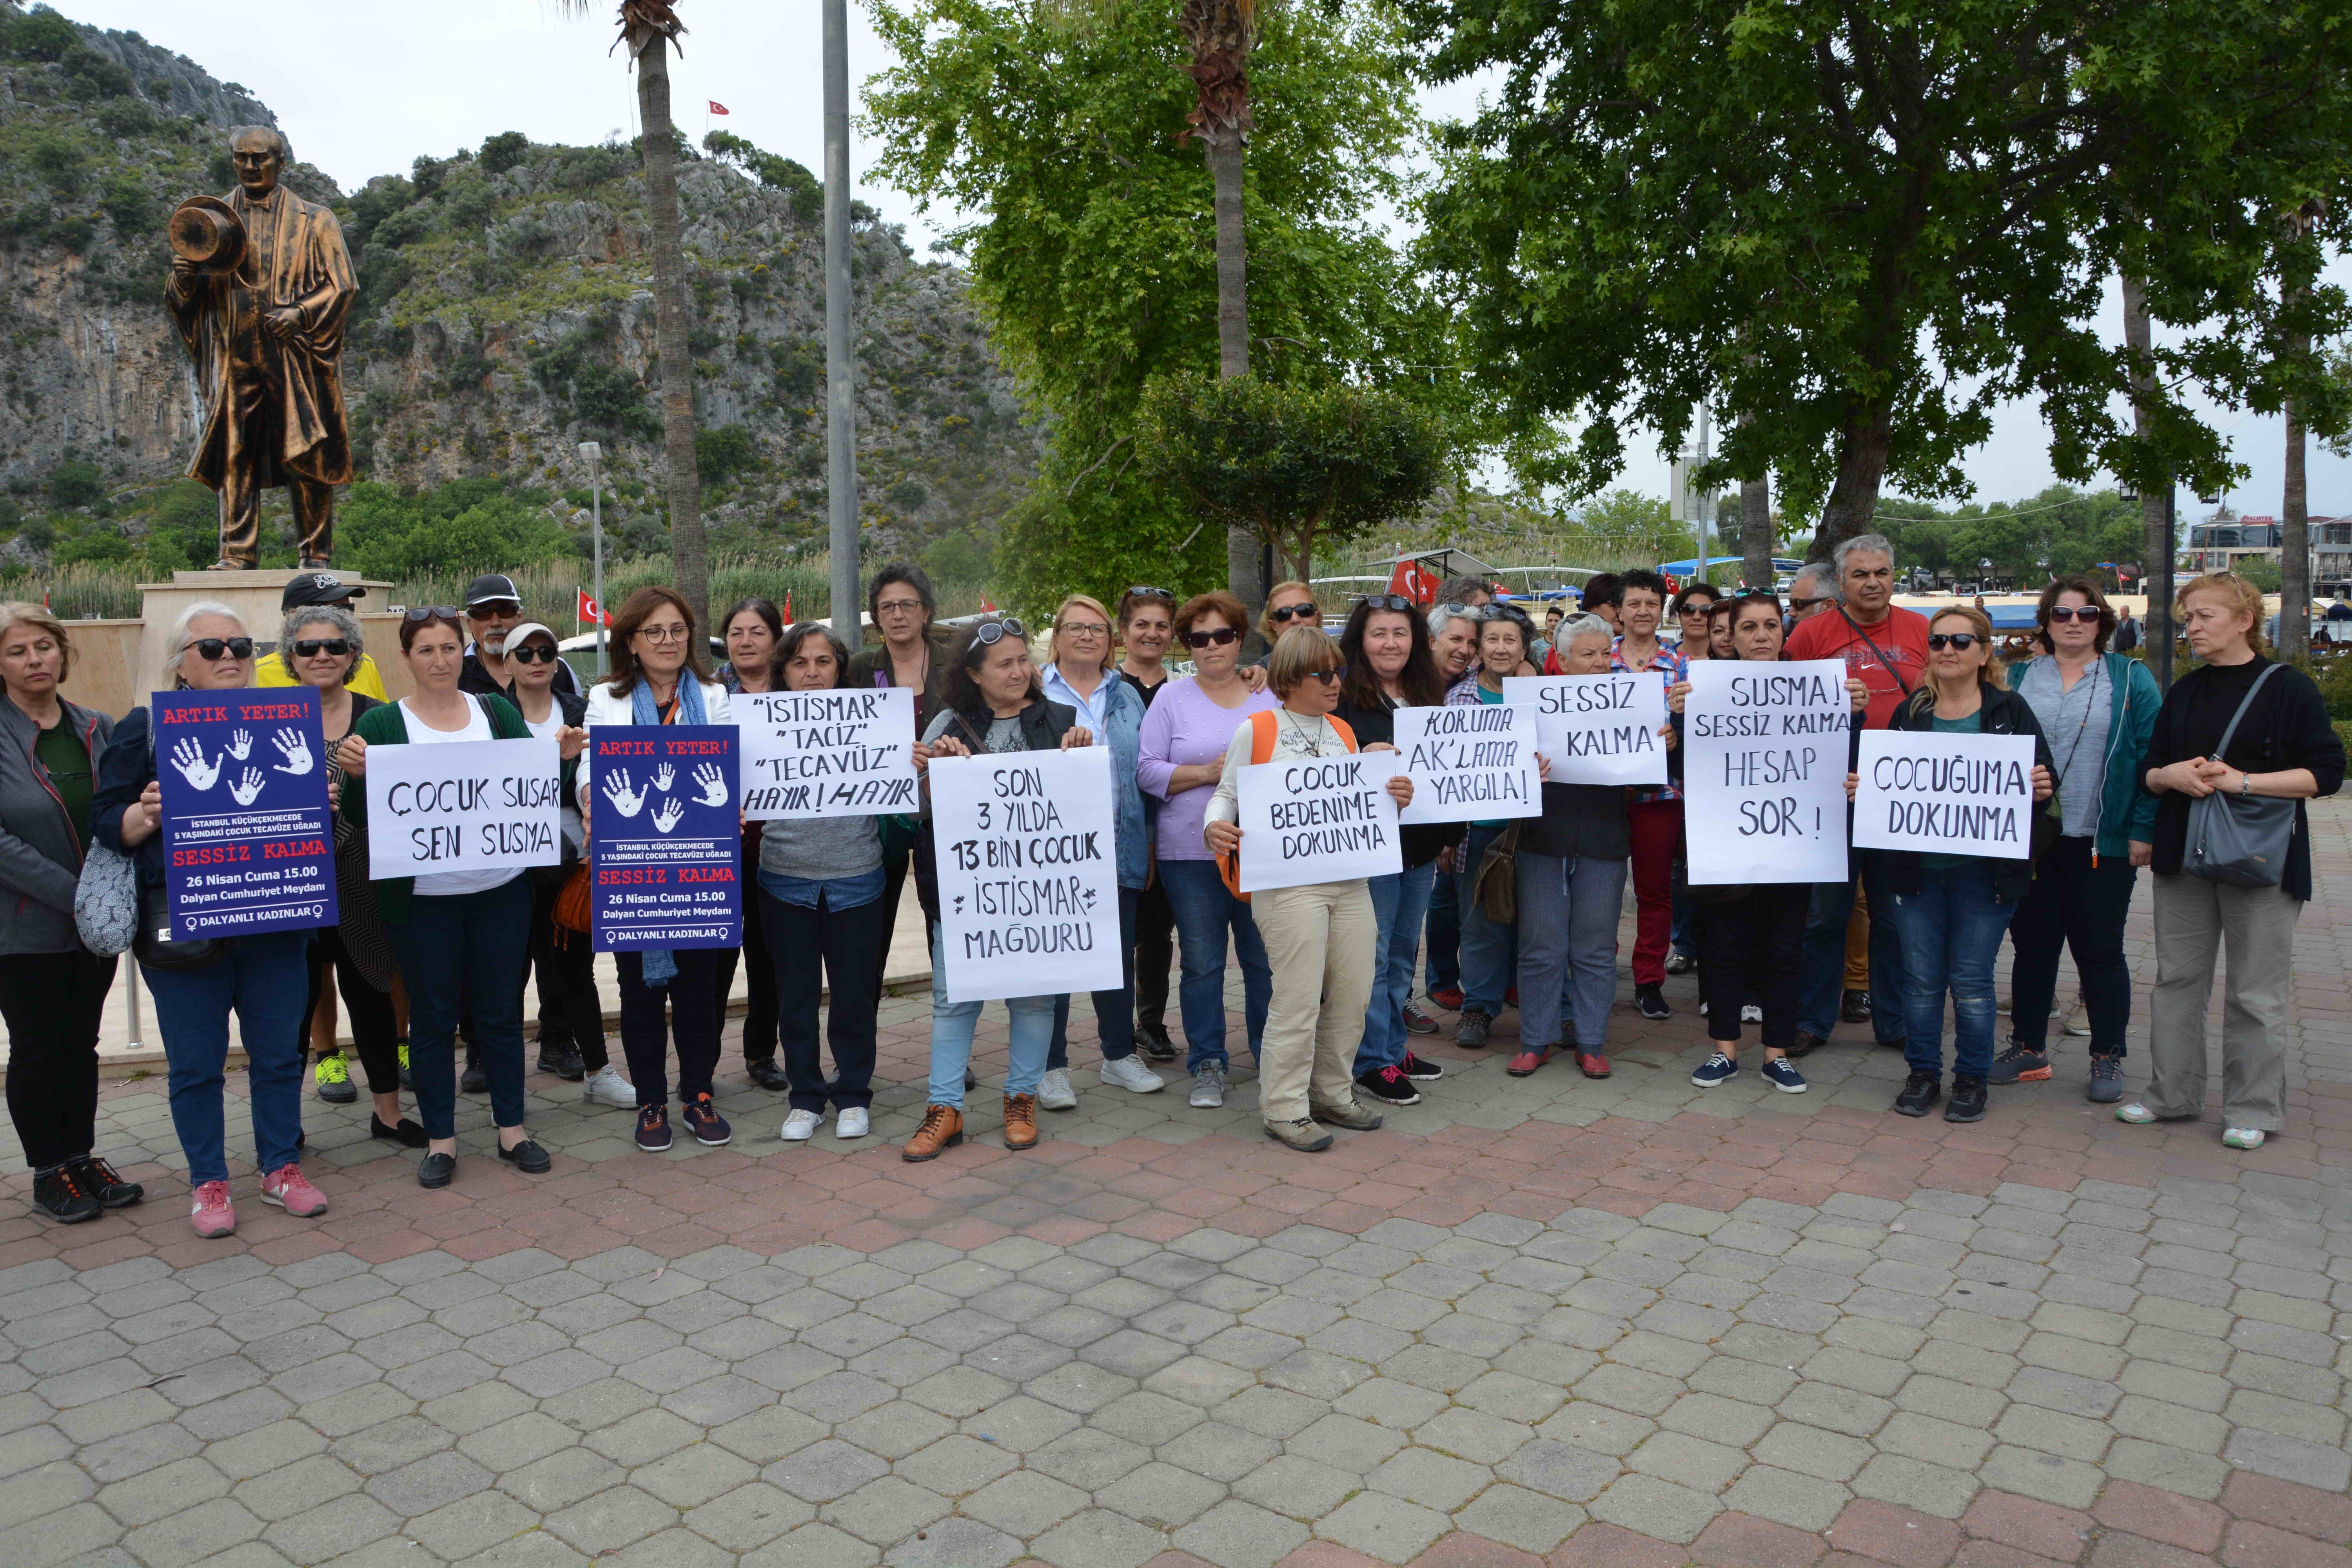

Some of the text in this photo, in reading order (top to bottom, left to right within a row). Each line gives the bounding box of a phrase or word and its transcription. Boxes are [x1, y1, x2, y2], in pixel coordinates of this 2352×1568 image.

[1540, 677, 1635, 713] SESSİZ
[163, 703, 308, 724] ARTIK YETER!
[1424, 708, 1513, 736] KORUMA
[1695, 711, 1849, 737] SESSİZ KALMA
[599, 740, 727, 755] ARTIK YETER!
[1409, 739, 1516, 771] AK'LAMA
[1568, 726, 1653, 756] KALMA
[1286, 762, 1366, 795] ÇOCUK
[1726, 748, 1816, 786] HESAP
[1875, 755, 2025, 795] ÇOCUĞUMA
[388, 777, 559, 816] ÇOCUK SUSAR
[828, 779, 915, 806] HAYIR
[994, 768, 1042, 797] SON
[1431, 770, 1527, 804] YARGILA!
[191, 814, 302, 828] İSTANBUL KÜÇÜKÇEKMECEDE
[978, 800, 1063, 832] 3 YILDA
[1271, 791, 1377, 829] BEDENİME
[1889, 801, 2017, 842] DOKUNMA
[181, 828, 223, 839] YAŞINDAKİ
[225, 827, 251, 836] ÇOCUK
[252, 823, 291, 833] TECAVÜZE
[412, 822, 553, 860] SEN SUSMA
[1283, 824, 1386, 859] DOKUNMA
[173, 840, 326, 866] SESSİZ KALMA
[607, 852, 644, 861] YAŞINDAKİ
[652, 842, 714, 851] KÜÇÜKÇEKMECEDE
[951, 831, 1101, 870] 13 BİN ÇOCUK
[187, 866, 317, 887] 26 Nisan Cuma 15.00
[599, 866, 735, 884] SESSİZ KALMA
[181, 883, 325, 904] Dalyan Cumhuriyet Meydanı
[609, 892, 725, 904] 26 Nisan Cuma 15.00
[975, 875, 1086, 916] İSTİSMAR
[200, 907, 311, 926] DALYANLI KADINLAR
[603, 907, 731, 920] Dalyan Cumhuriyet Meydanı
[619, 929, 717, 940] DALYANLI KADINLAR
[965, 922, 1092, 958] MAĞDURU
